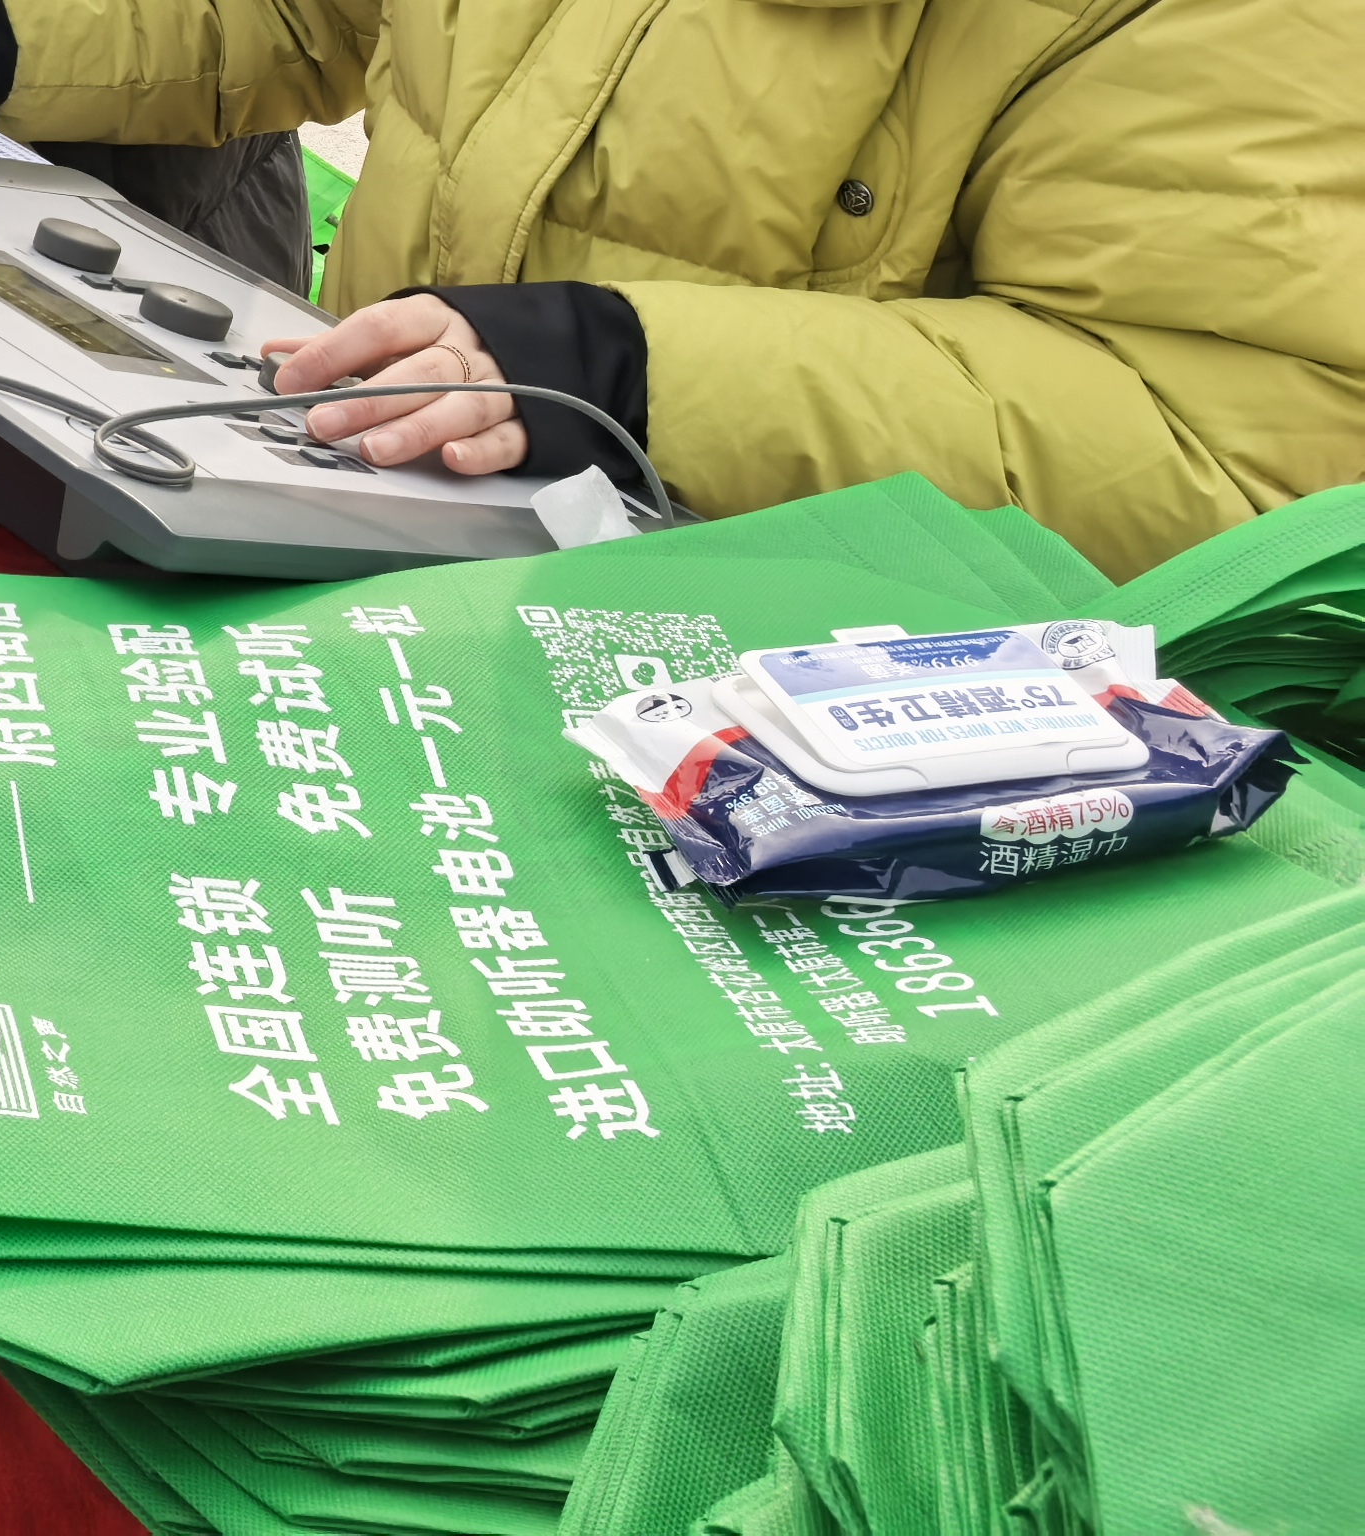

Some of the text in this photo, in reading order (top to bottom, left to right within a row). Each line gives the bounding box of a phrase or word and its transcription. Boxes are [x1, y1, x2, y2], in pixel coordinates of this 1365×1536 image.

[854, 707, 1097, 753] ANTIVIRUS WET WIPES FOR OBJECTS
[749, 814, 790, 837] WIPES
[989, 795, 1131, 837] 含酒精75%
[107, 624, 339, 1125] 全国连锁 专业验配
[224, 624, 490, 1121] 免费测听 免费试听
[342, 604, 660, 1141] 进口助听器电池一元一粒
[978, 832, 1129, 876] 酒精湿巾
[31, 1016, 88, 1114] 自然之声
